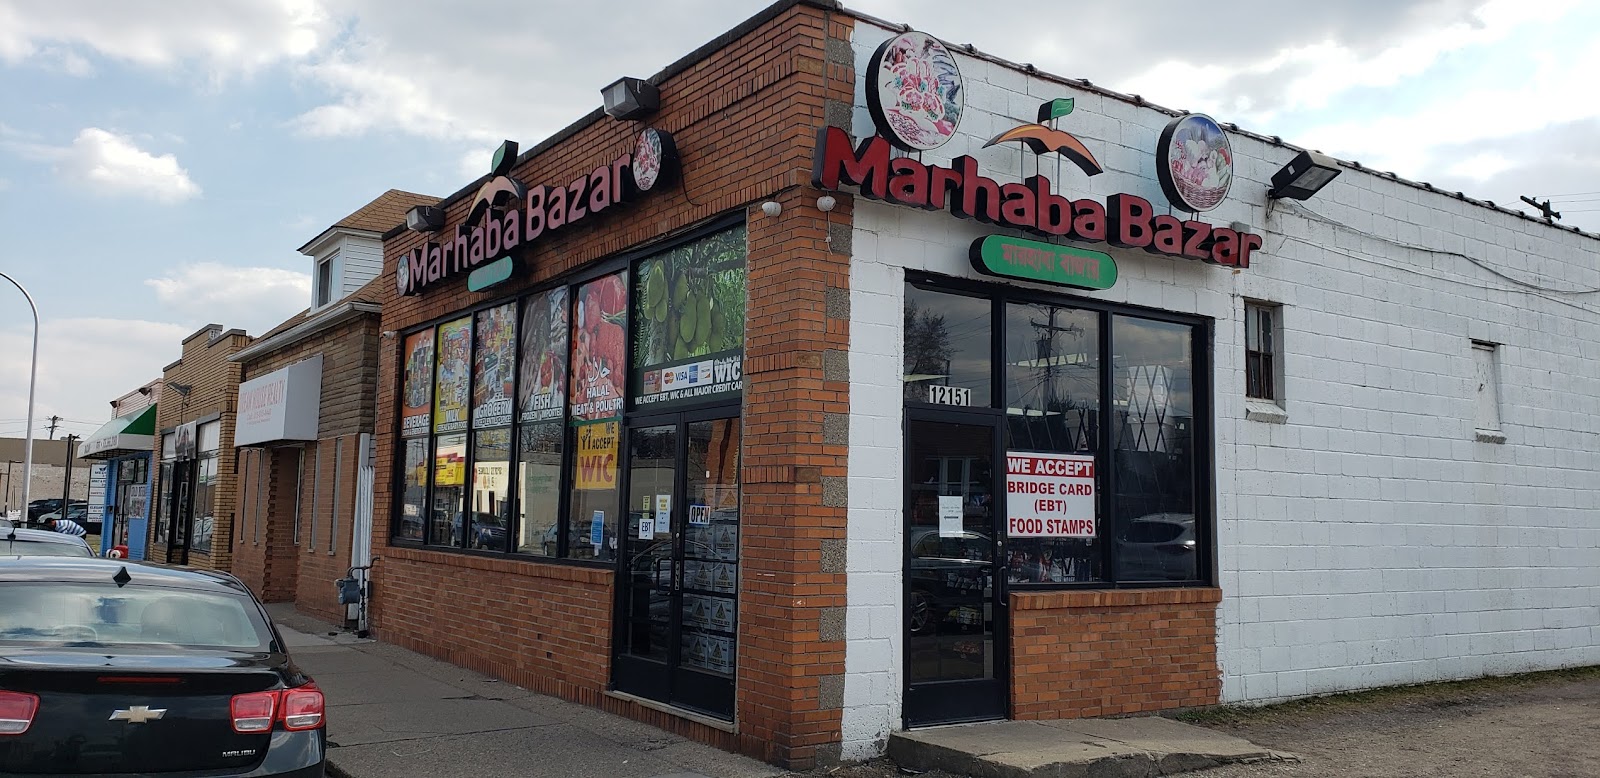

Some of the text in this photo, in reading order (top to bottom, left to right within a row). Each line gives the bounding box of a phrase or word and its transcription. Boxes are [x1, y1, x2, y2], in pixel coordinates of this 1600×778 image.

[817, 126, 1262, 268] Marhaba Bazar
[408, 153, 631, 292] Marhaba Bazar
[675, 371, 688, 381] VISA
[714, 361, 741, 384] WIC
[586, 384, 610, 399] HALAL
[634, 397, 643, 405] WE
[642, 394, 659, 403] ACCEPT
[670, 390, 680, 398] WIC
[684, 388, 694, 397] ALL
[694, 386, 712, 396] MAJOR
[712, 383, 731, 393] CREDIT
[930, 386, 970, 406] 12151
[478, 399, 512, 418] GROCERY
[534, 393, 551, 411] FISH
[571, 403, 588, 416] MEAT
[589, 401, 594, 414] &
[445, 408, 460, 423] MILK
[521, 408, 564, 421] FROZEN IMPORTED
[605, 422, 615, 434] WE
[591, 436, 615, 450] ACCEPT
[580, 453, 614, 483] WIC
[1007, 459, 1093, 476] WE ACCEPT
[1007, 481, 1092, 496] BRIDGE CARD
[691, 506, 709, 523] OPEN
[1033, 498, 1068, 515] (EBT)
[641, 521, 652, 532] EBT
[1009, 518, 1094, 535] FOOD STAMPS
[222, 749, 256, 757] MALIBU
